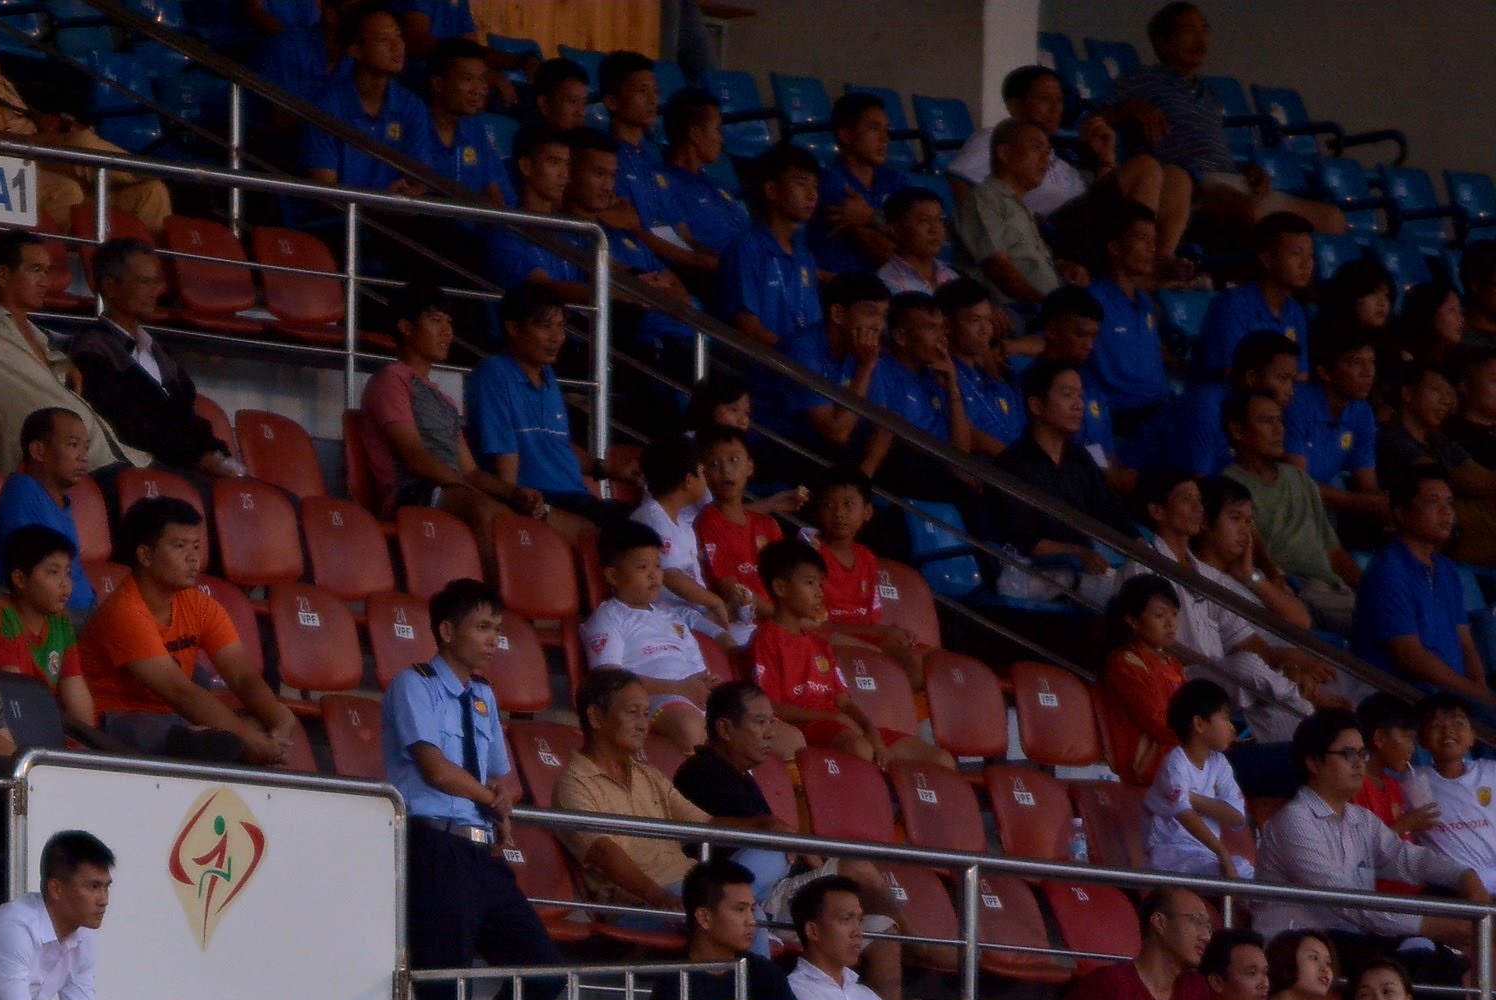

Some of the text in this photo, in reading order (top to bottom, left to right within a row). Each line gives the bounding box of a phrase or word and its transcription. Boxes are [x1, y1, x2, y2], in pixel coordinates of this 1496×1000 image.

[240, 493, 254, 510] 25
[300, 614, 318, 624] VPF
[395, 626, 412, 636] VPF
[824, 759, 840, 774] 26
